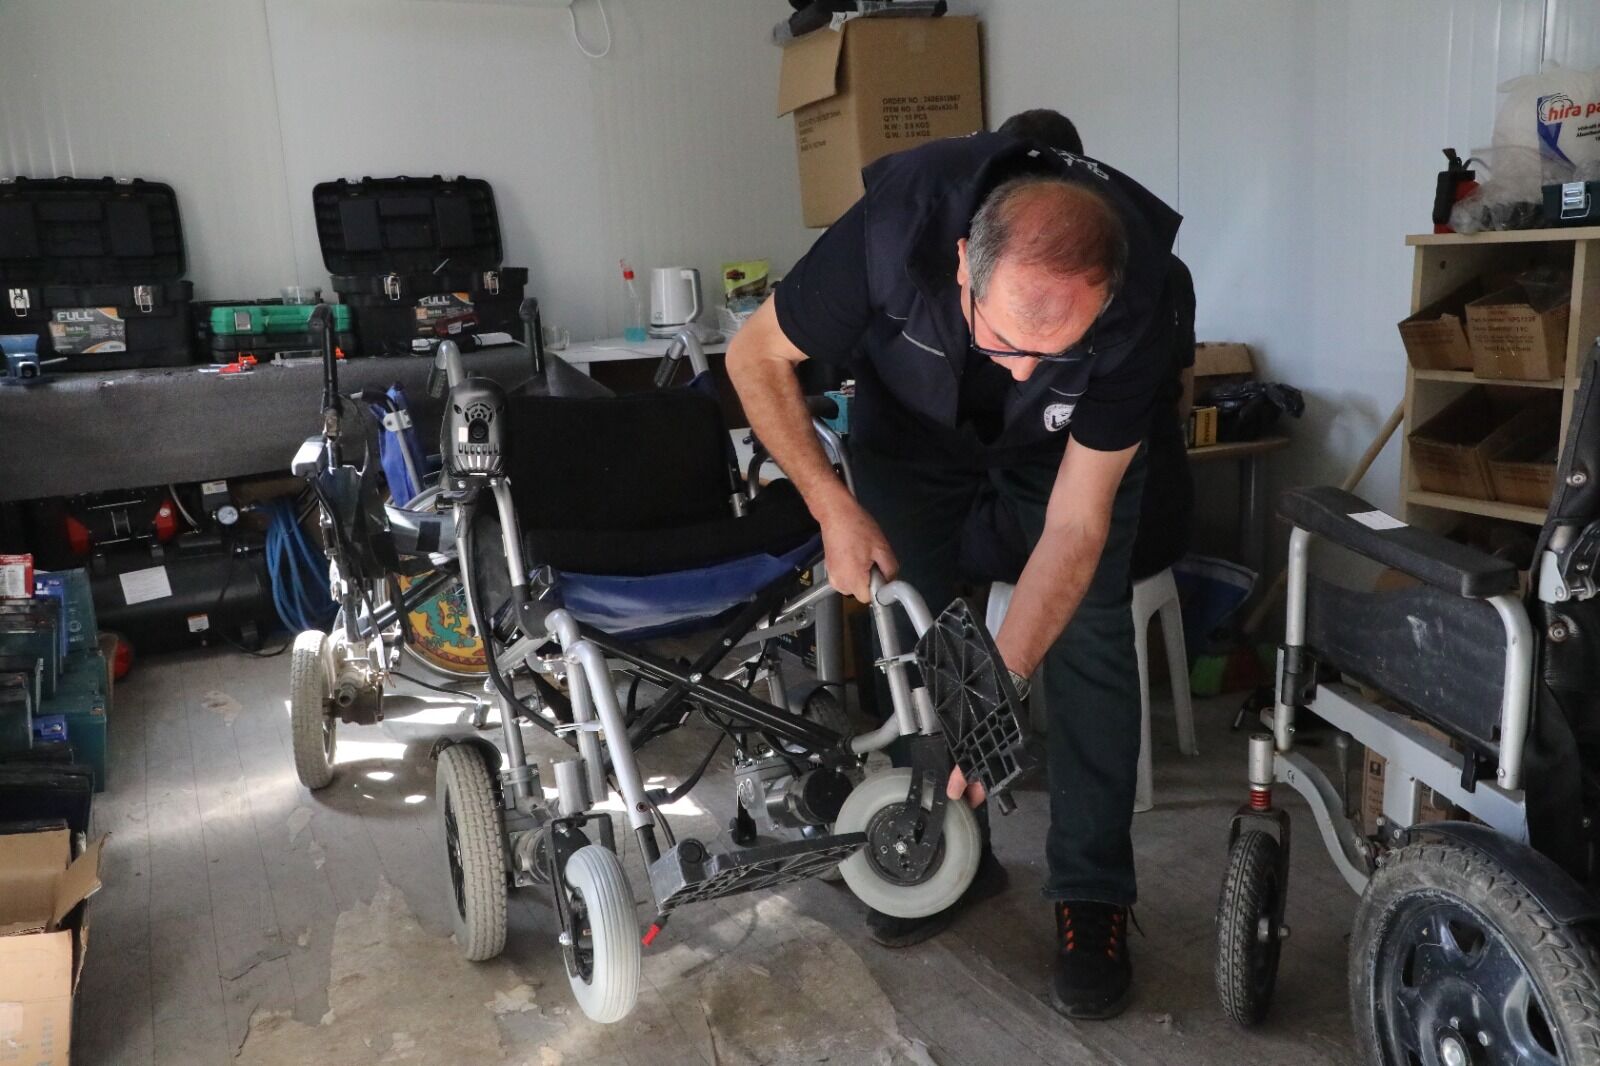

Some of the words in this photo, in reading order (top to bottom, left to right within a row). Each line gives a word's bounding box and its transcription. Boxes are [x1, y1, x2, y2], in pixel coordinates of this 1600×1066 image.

[882, 97, 906, 105] ORDER
[914, 113, 928, 121] PCS
[1548, 104, 1582, 122] hira
[418, 296, 450, 306] FULL
[57, 311, 94, 322] FULL
